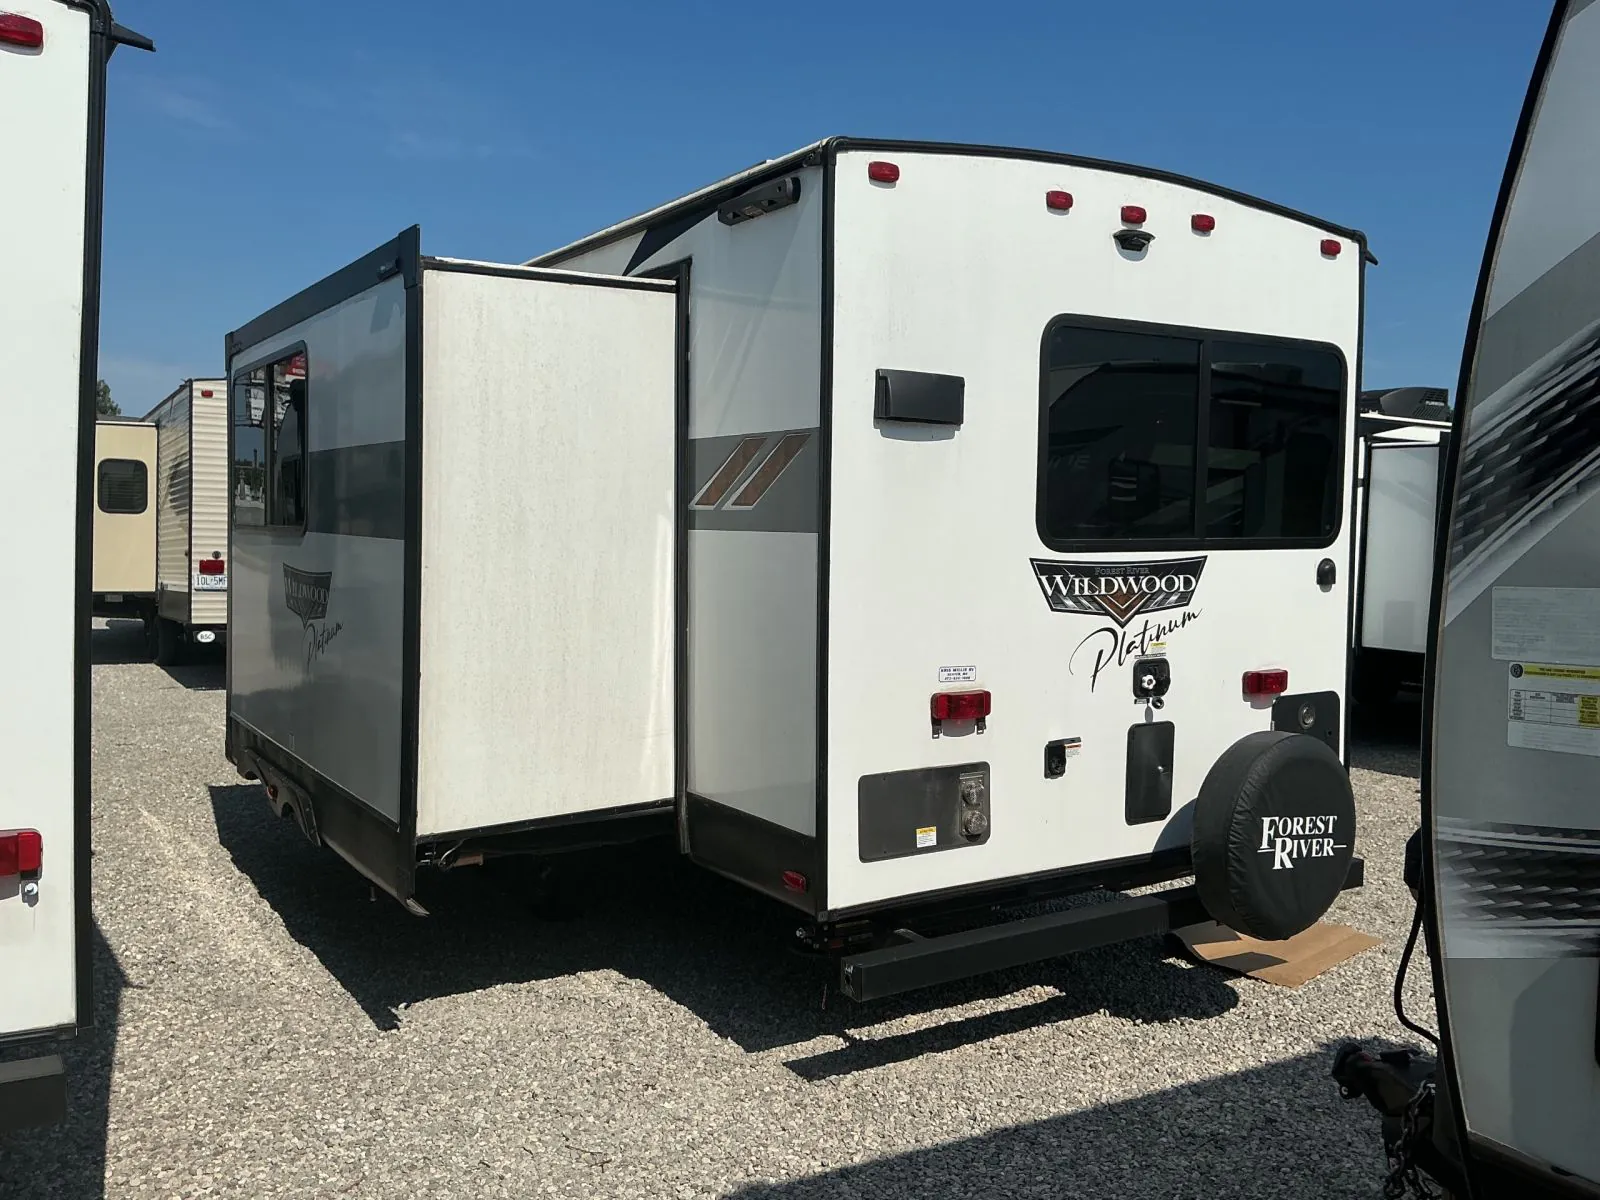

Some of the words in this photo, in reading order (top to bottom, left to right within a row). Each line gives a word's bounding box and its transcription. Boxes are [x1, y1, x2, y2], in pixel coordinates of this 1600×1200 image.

[1038, 574, 1196, 597] WILDWOOD
[1095, 567, 1125, 575] FOREST
[1126, 566, 1150, 575] RIVER
[1068, 608, 1203, 693] Platinum
[1260, 815, 1338, 849] FOREST
[1272, 837, 1335, 870] RIVER
